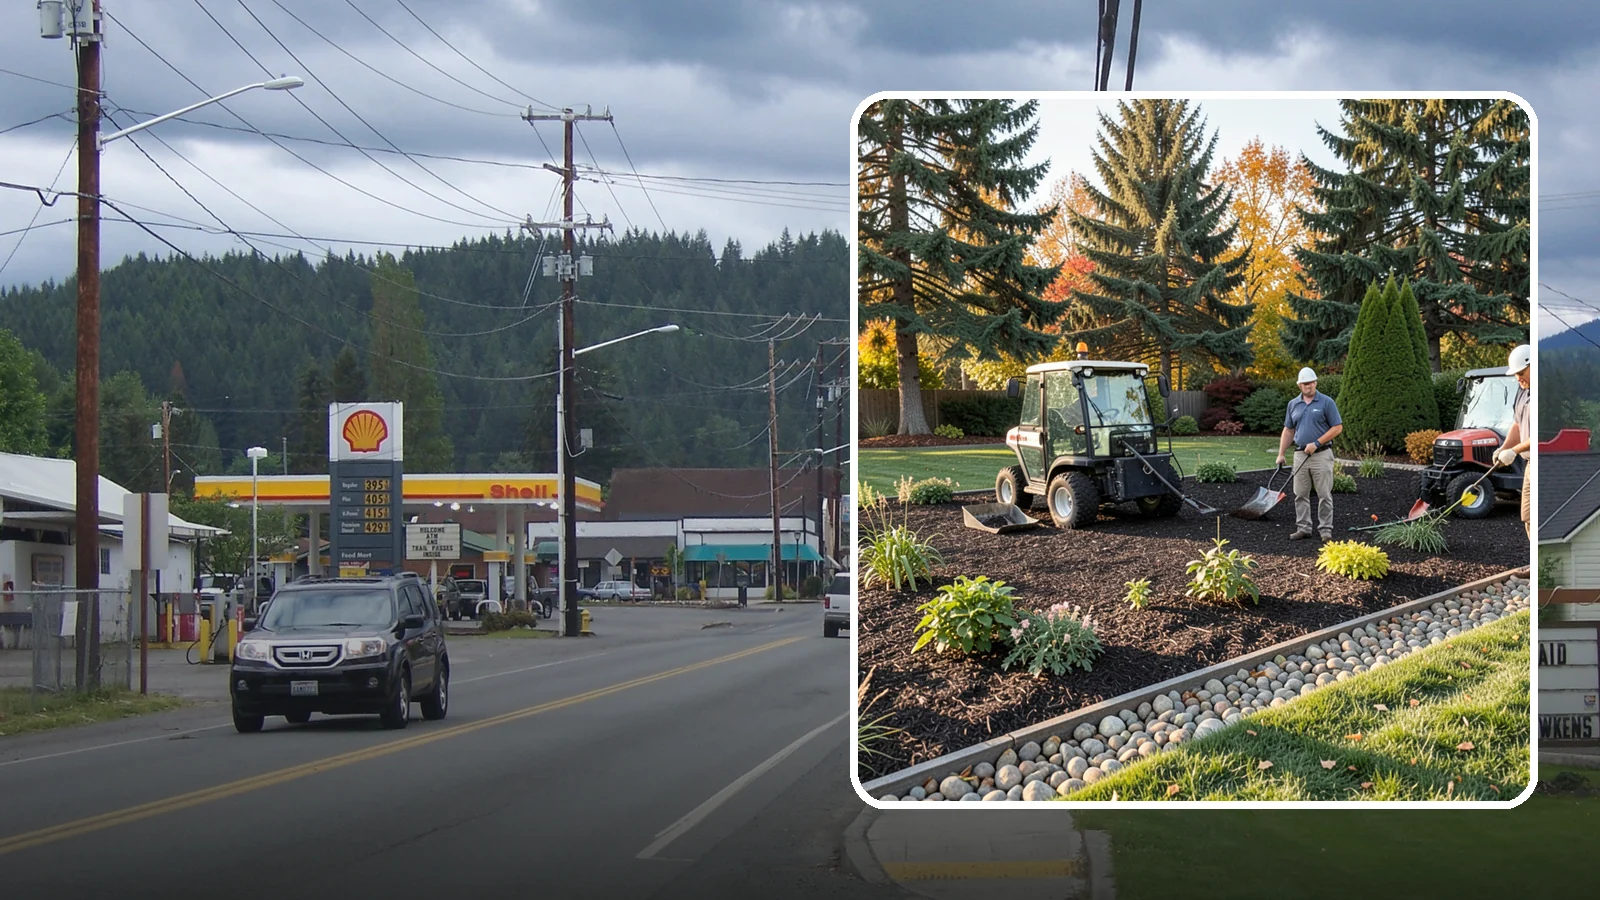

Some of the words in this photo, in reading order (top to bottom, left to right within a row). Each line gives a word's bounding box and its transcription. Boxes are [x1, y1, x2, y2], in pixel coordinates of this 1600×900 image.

[366, 480, 383, 490] 395
[490, 484, 547, 499] Shell
[366, 494, 383, 504] 405
[366, 508, 383, 518] 415
[366, 522, 383, 532] 429
